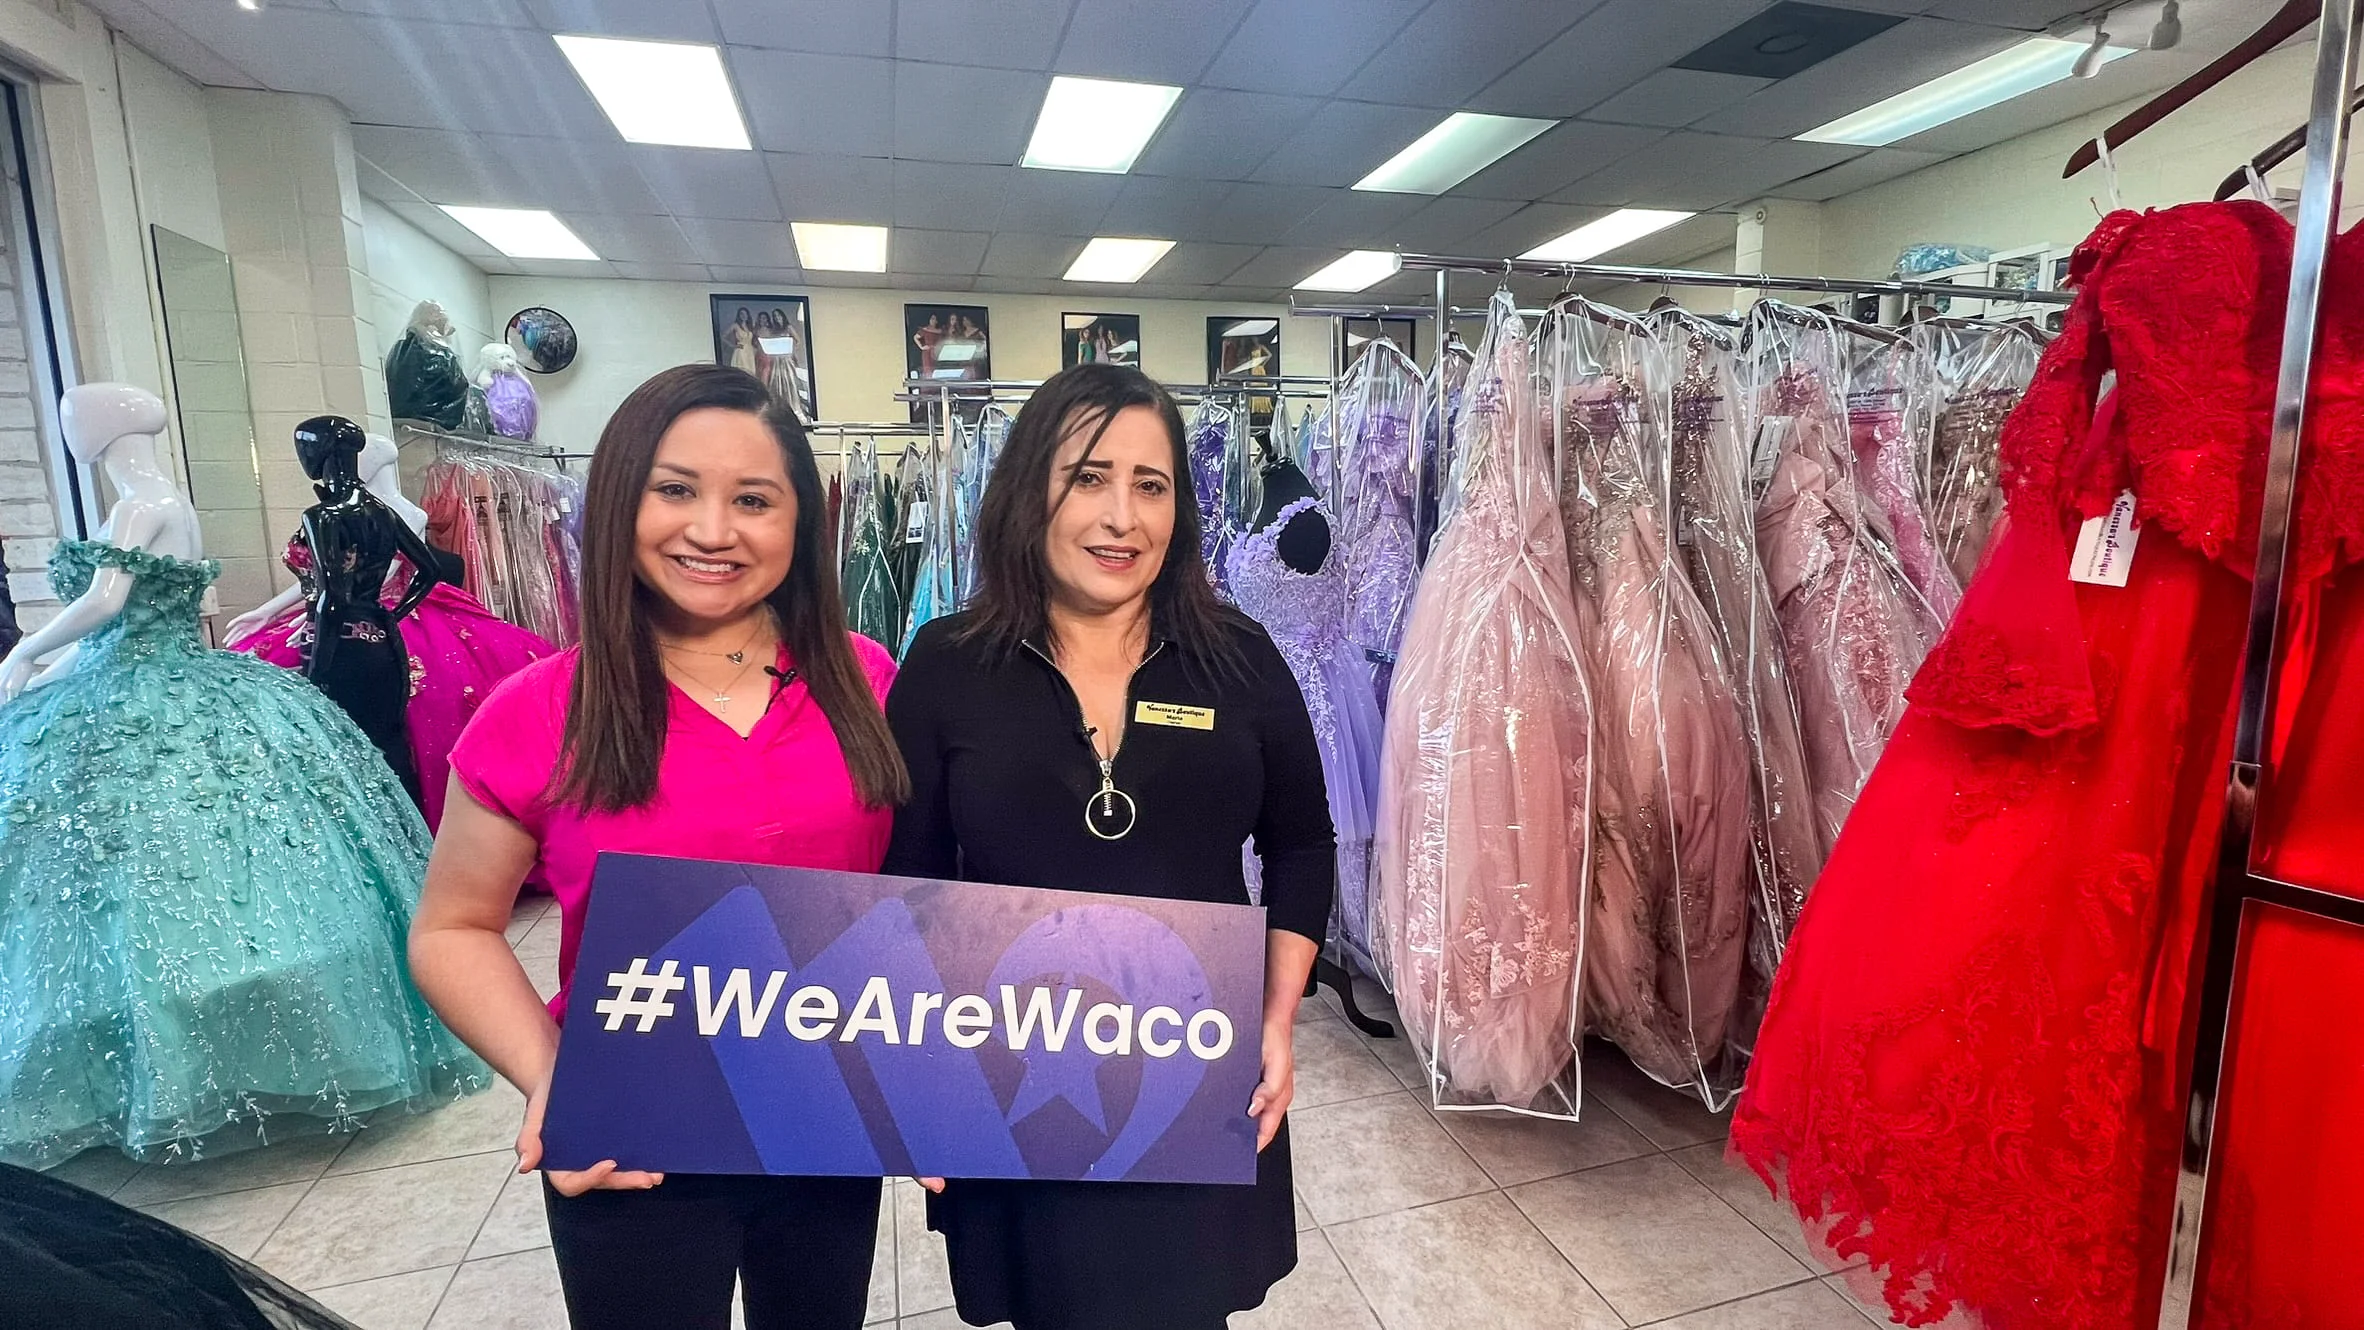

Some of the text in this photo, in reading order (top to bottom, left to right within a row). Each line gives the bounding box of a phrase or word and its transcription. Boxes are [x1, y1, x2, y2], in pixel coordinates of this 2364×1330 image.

[2098, 539, 2119, 577] Boutique
[1176, 707, 1205, 717] Boutique
[595, 957, 1235, 1061] #WeAreWaco
